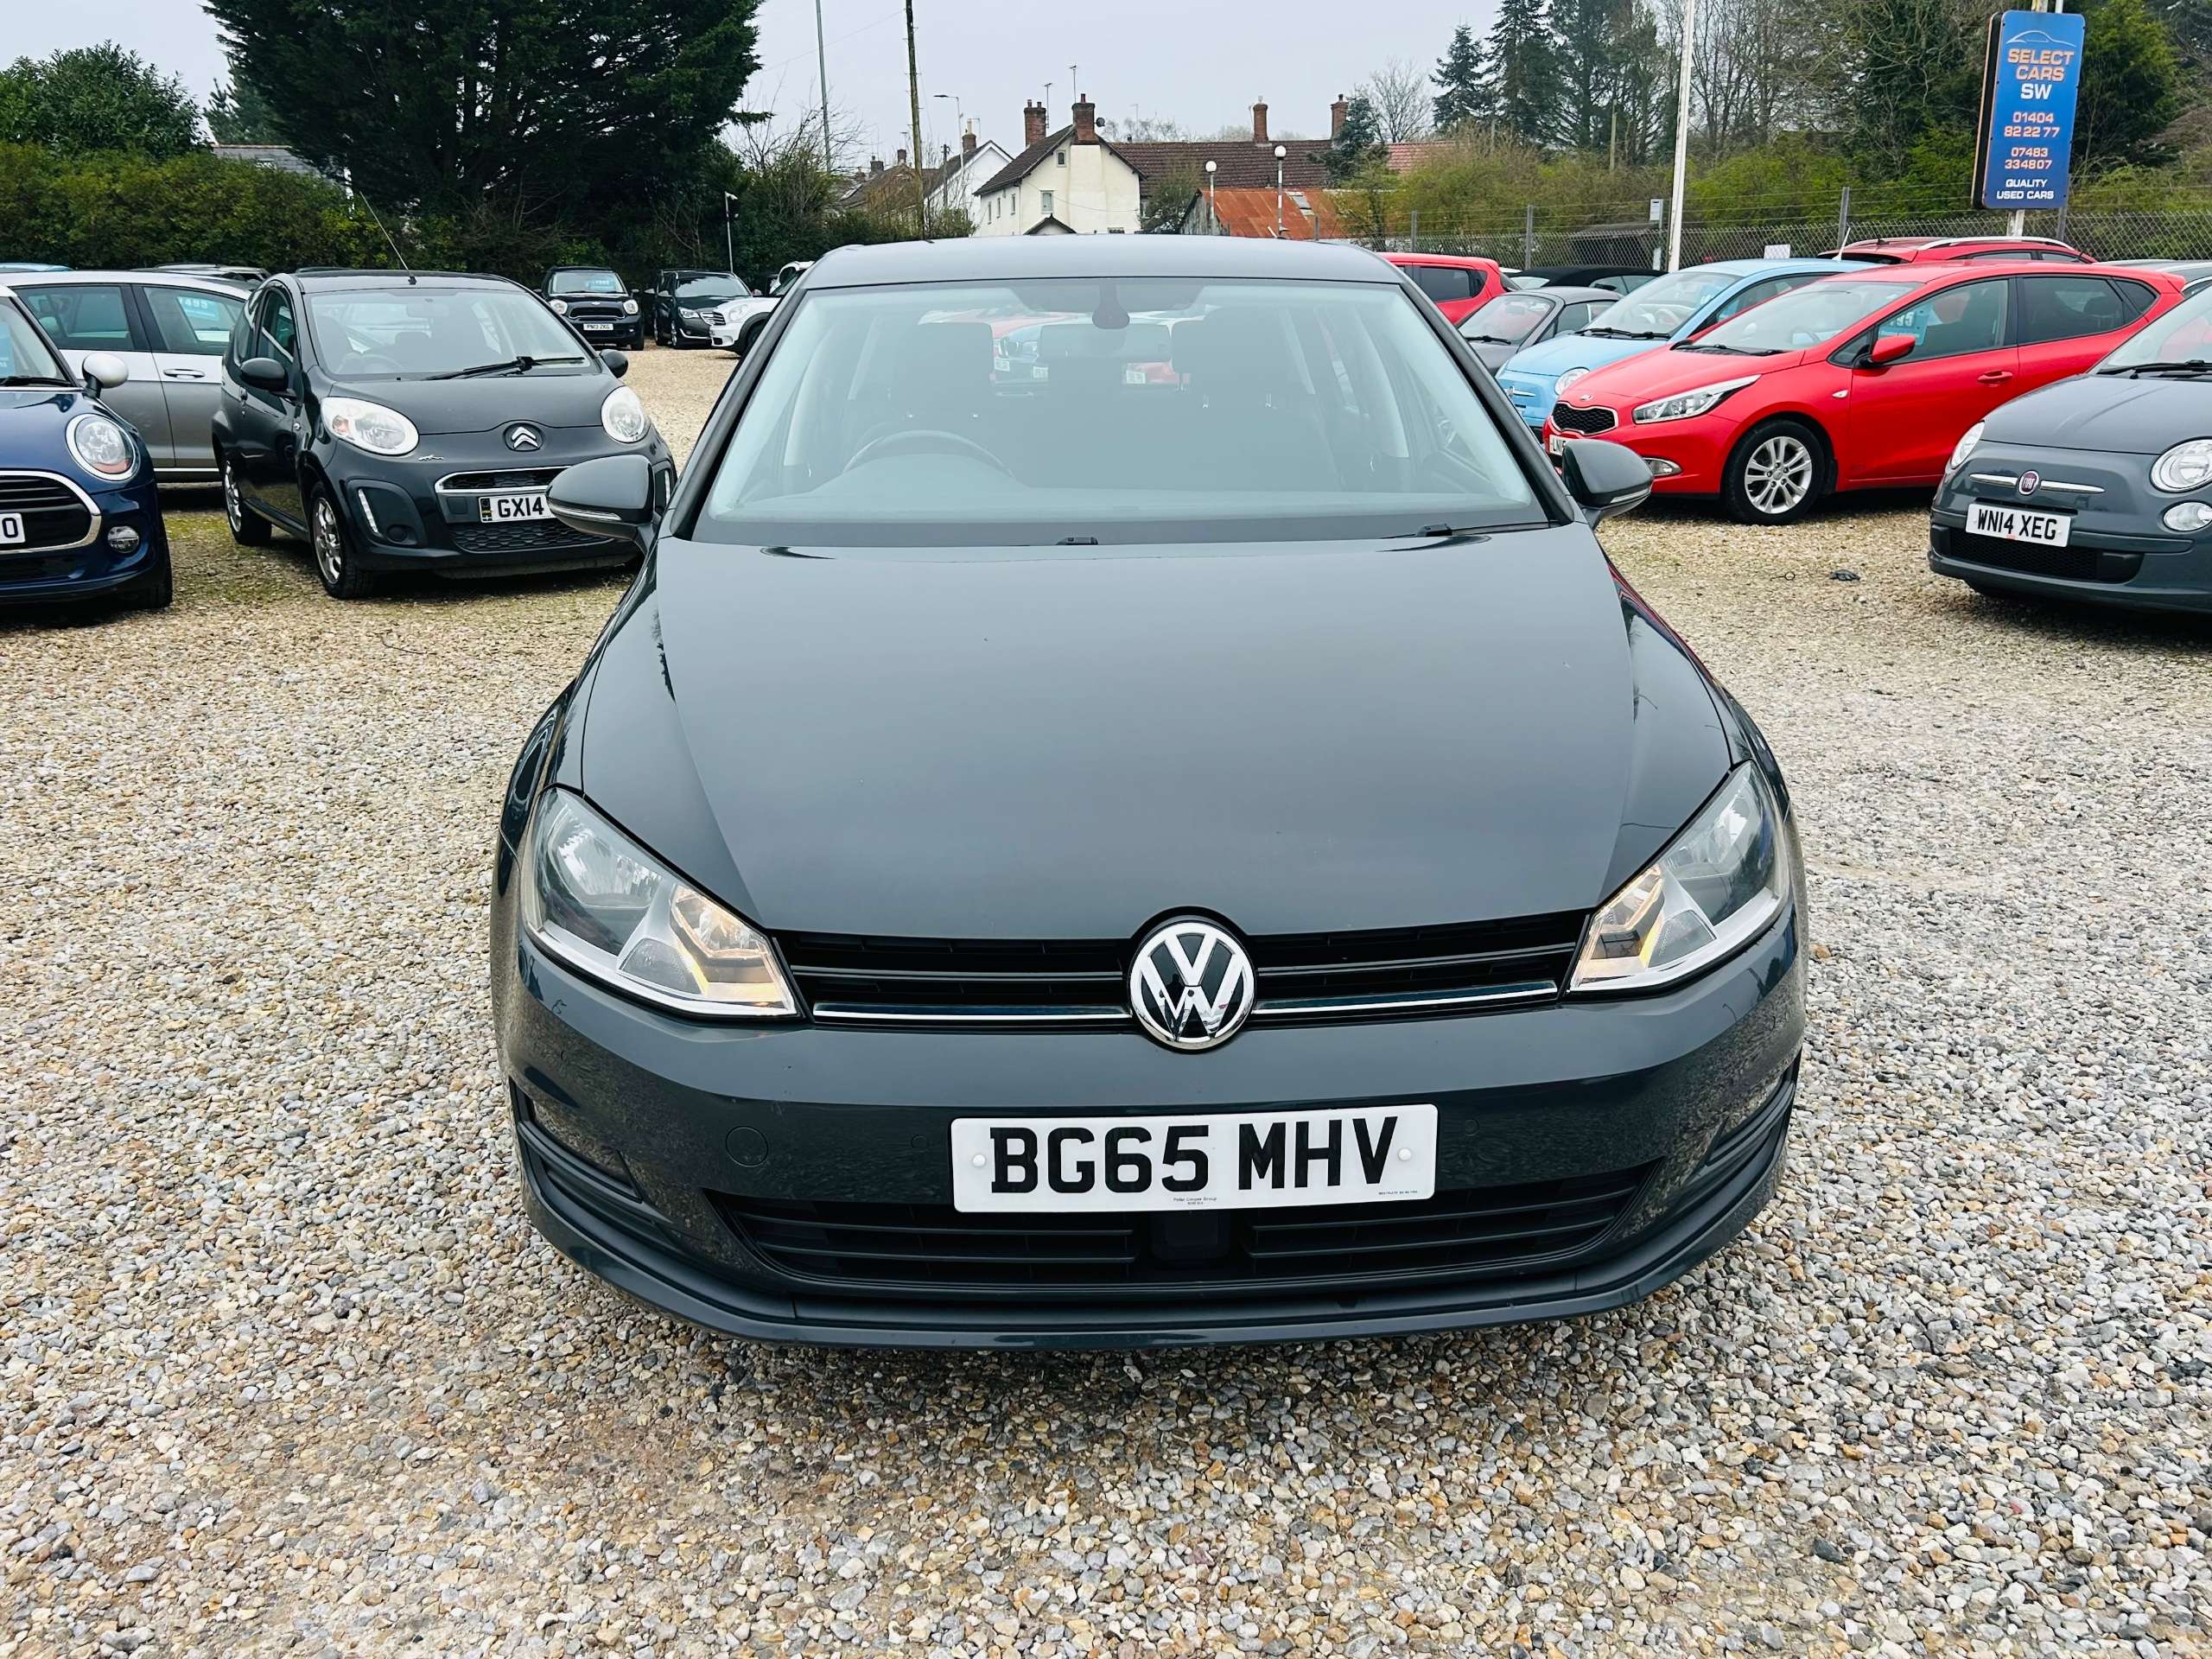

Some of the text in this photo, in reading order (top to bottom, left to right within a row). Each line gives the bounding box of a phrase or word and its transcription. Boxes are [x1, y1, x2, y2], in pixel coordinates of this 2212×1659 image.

[2007, 48, 2075, 65] SELECT
[2016, 67, 2065, 81] CARS
[2020, 83, 2052, 100] SW
[2012, 111, 2054, 124] 01404
[2004, 126, 2060, 138] 82 22 77
[2011, 147, 2049, 157] 07483
[2004, 159, 2052, 169] 334807
[2005, 179, 2048, 188] QUALITY
[1996, 190, 2055, 200] USED CARS
[497, 496, 544, 518] GX14
[1978, 508, 2058, 541] WN14 XEG
[989, 1116, 1399, 1194] BG65 MHV
